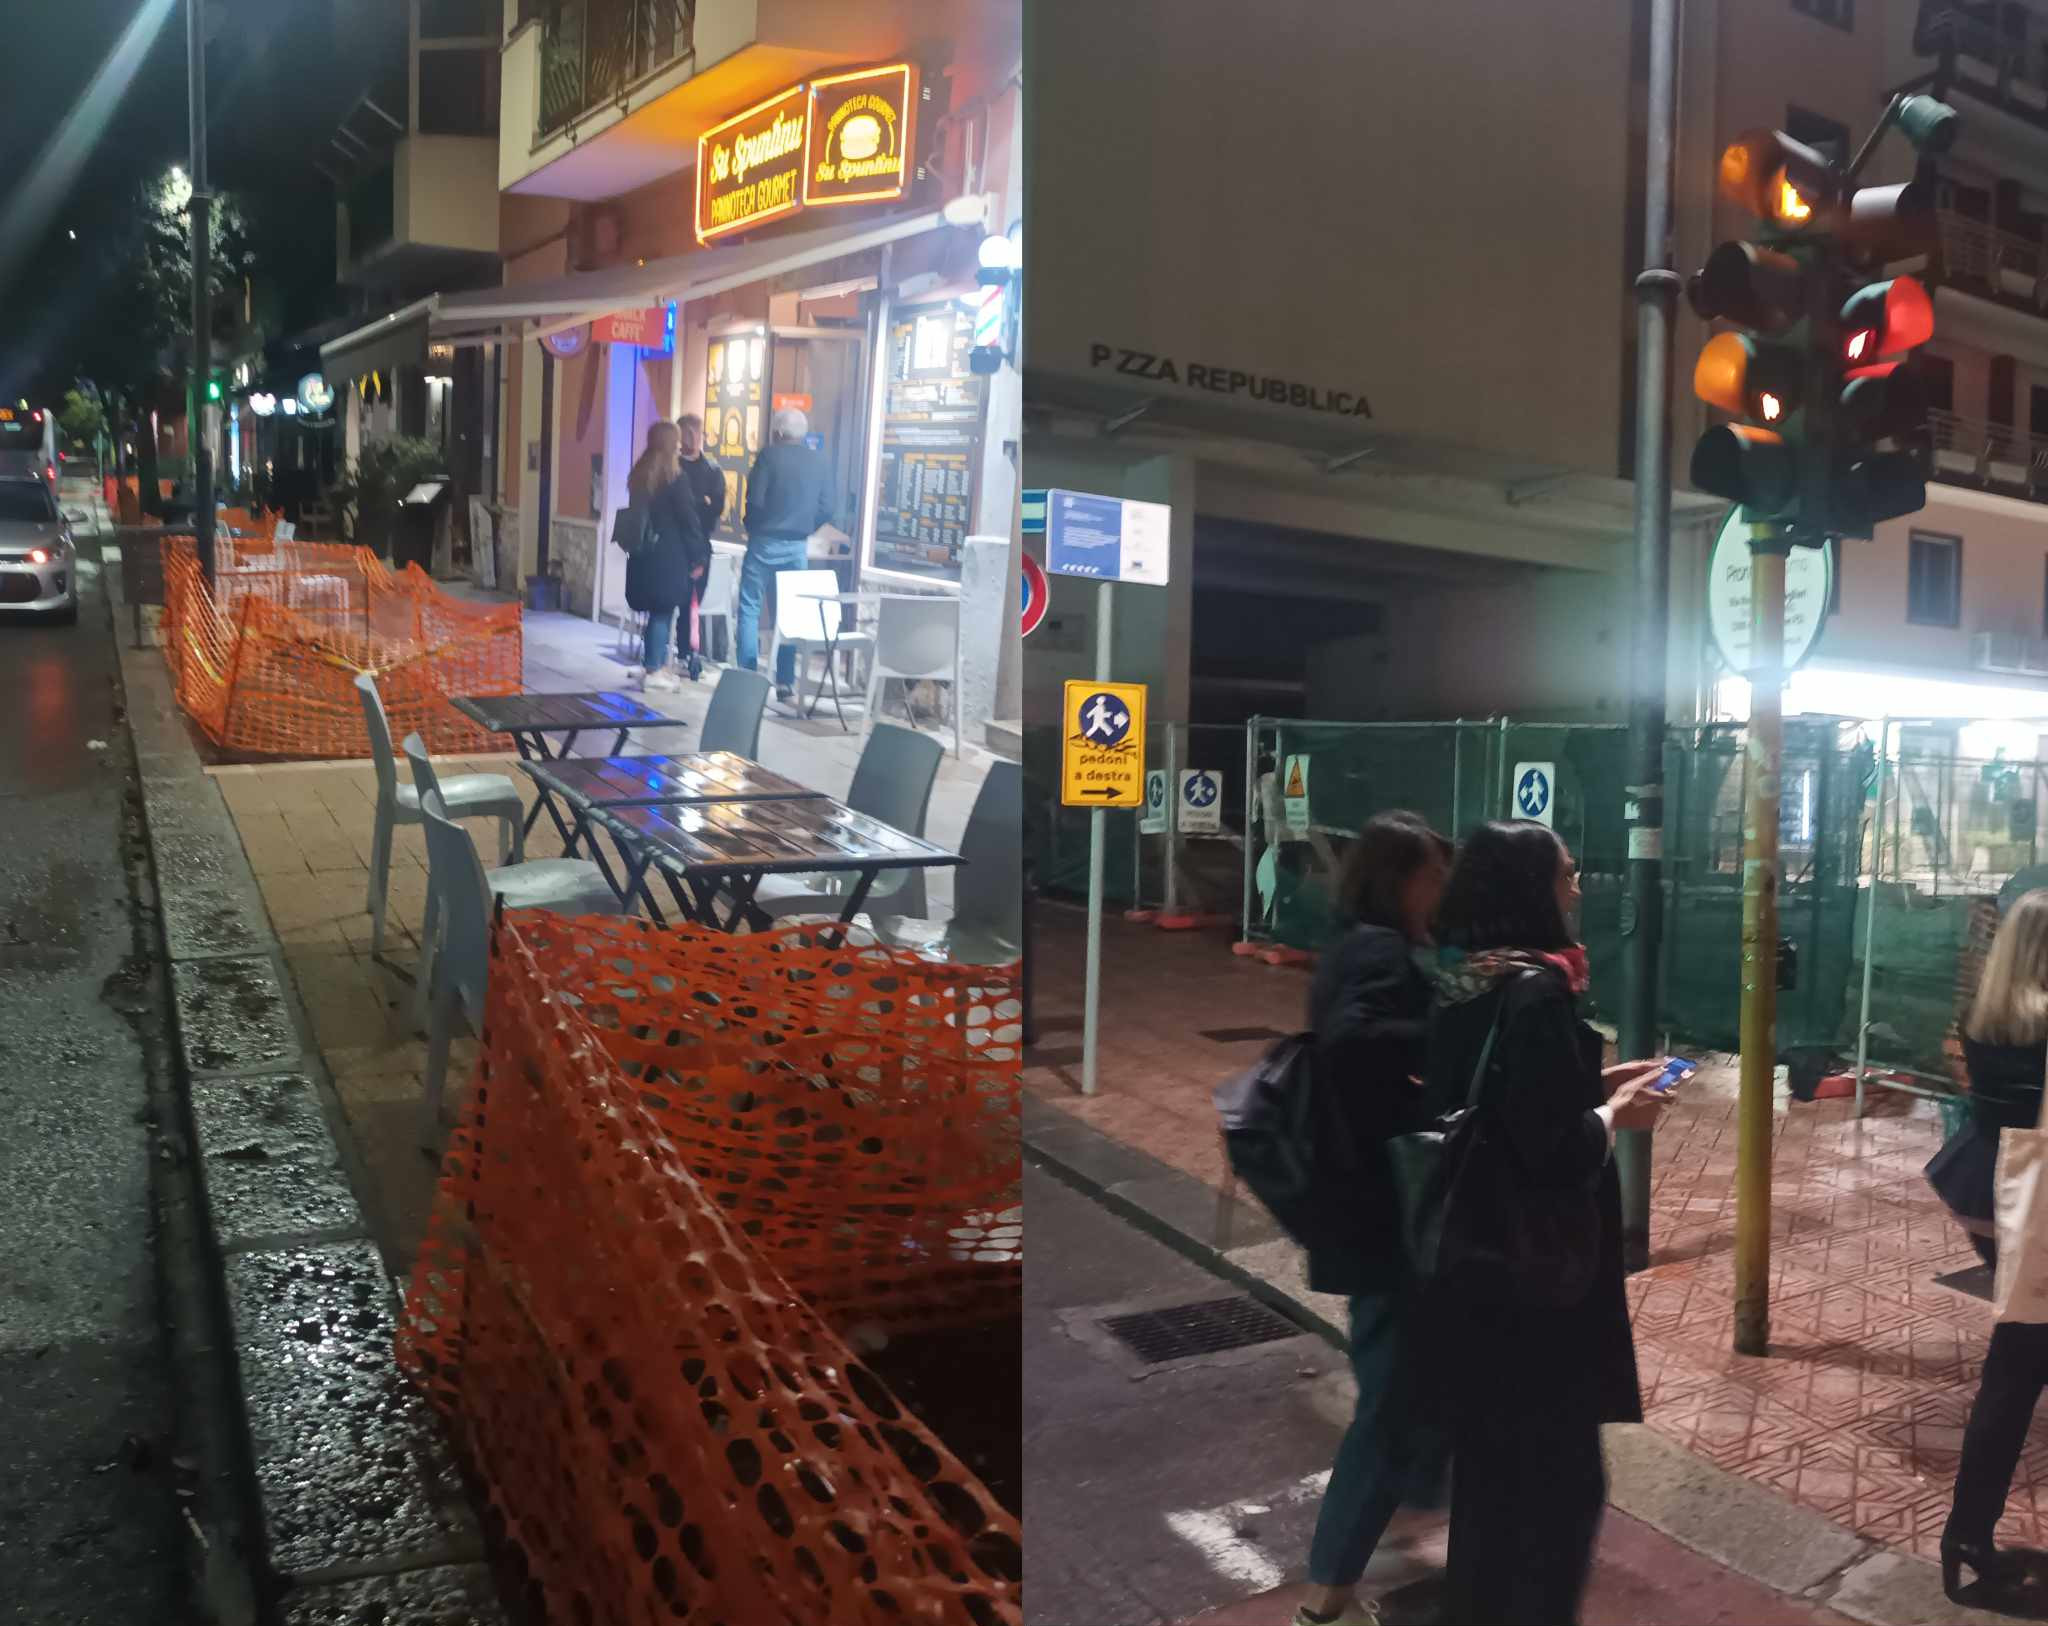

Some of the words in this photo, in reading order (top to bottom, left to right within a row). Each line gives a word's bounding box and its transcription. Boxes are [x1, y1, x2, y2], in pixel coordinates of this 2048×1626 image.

[757, 168, 798, 210] GOURMET
[1187, 362, 1373, 420] REPUBBLICA
[1080, 754, 1128, 766] pedoni
[1074, 772, 1082, 781] a
[1086, 770, 1132, 781] destra
